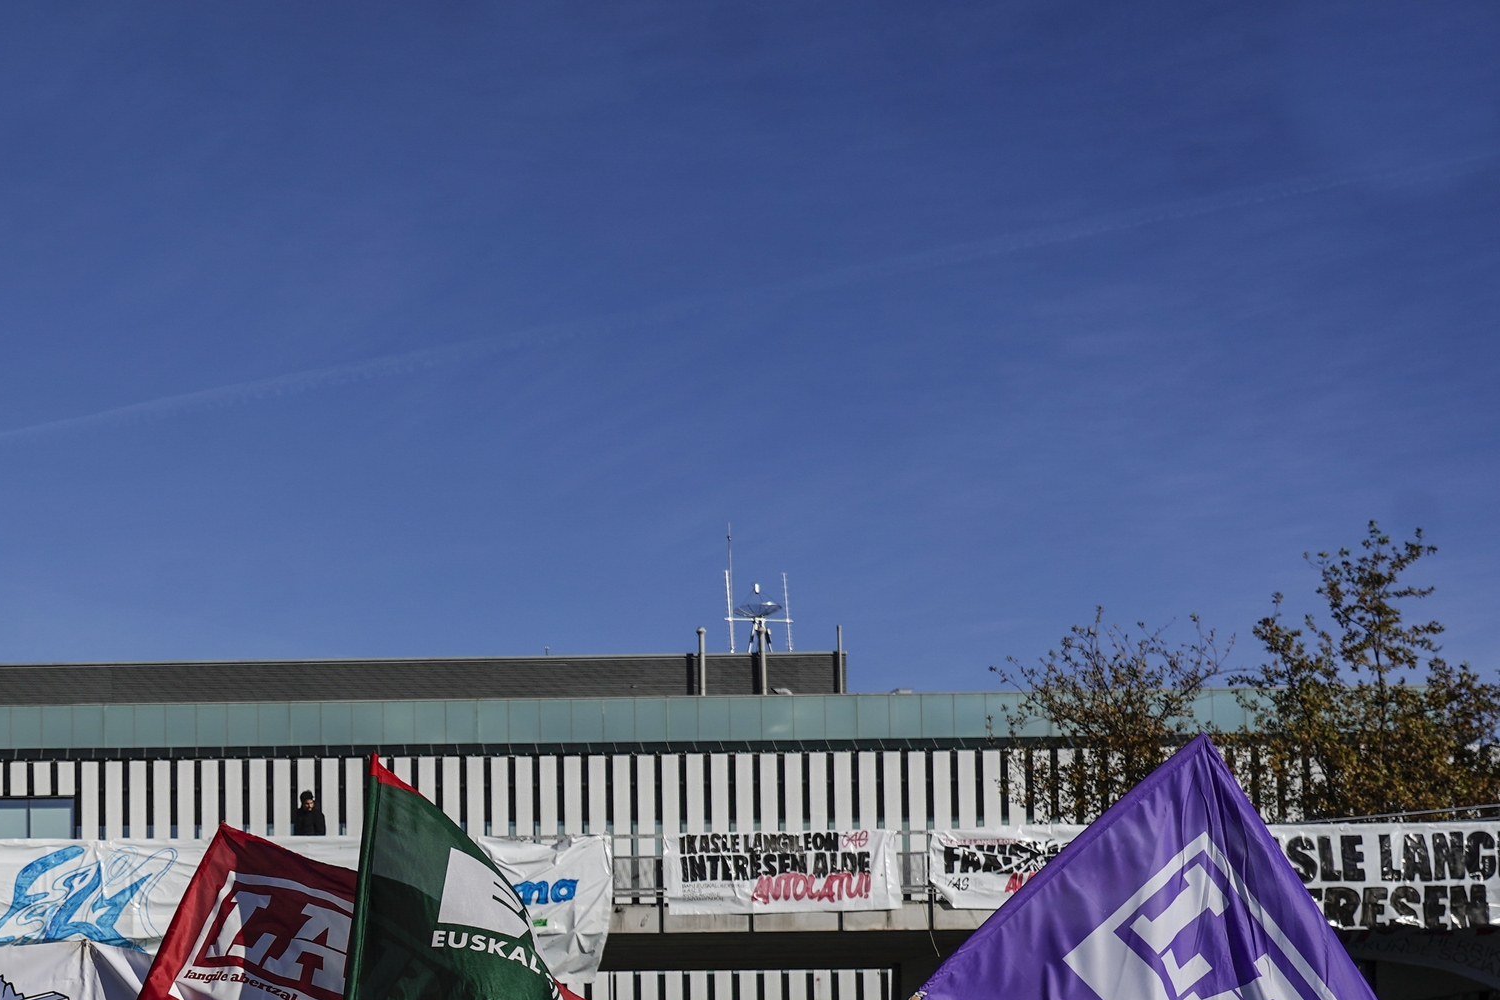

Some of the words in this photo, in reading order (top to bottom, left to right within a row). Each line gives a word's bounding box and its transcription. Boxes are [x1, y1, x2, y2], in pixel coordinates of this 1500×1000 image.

[680, 833, 740, 854] IKASLE
[744, 832, 838, 853] LANGILEON
[1275, 834, 1366, 884] SLE
[1379, 831, 1500, 882] LANG
[680, 851, 808, 882] INTERESEN
[812, 851, 871, 879] ALDE
[1307, 885, 1490, 929] RESEN
[205, 891, 353, 994] LA
[431, 930, 541, 975] EUSKAL
[184, 969, 228, 984] langile
